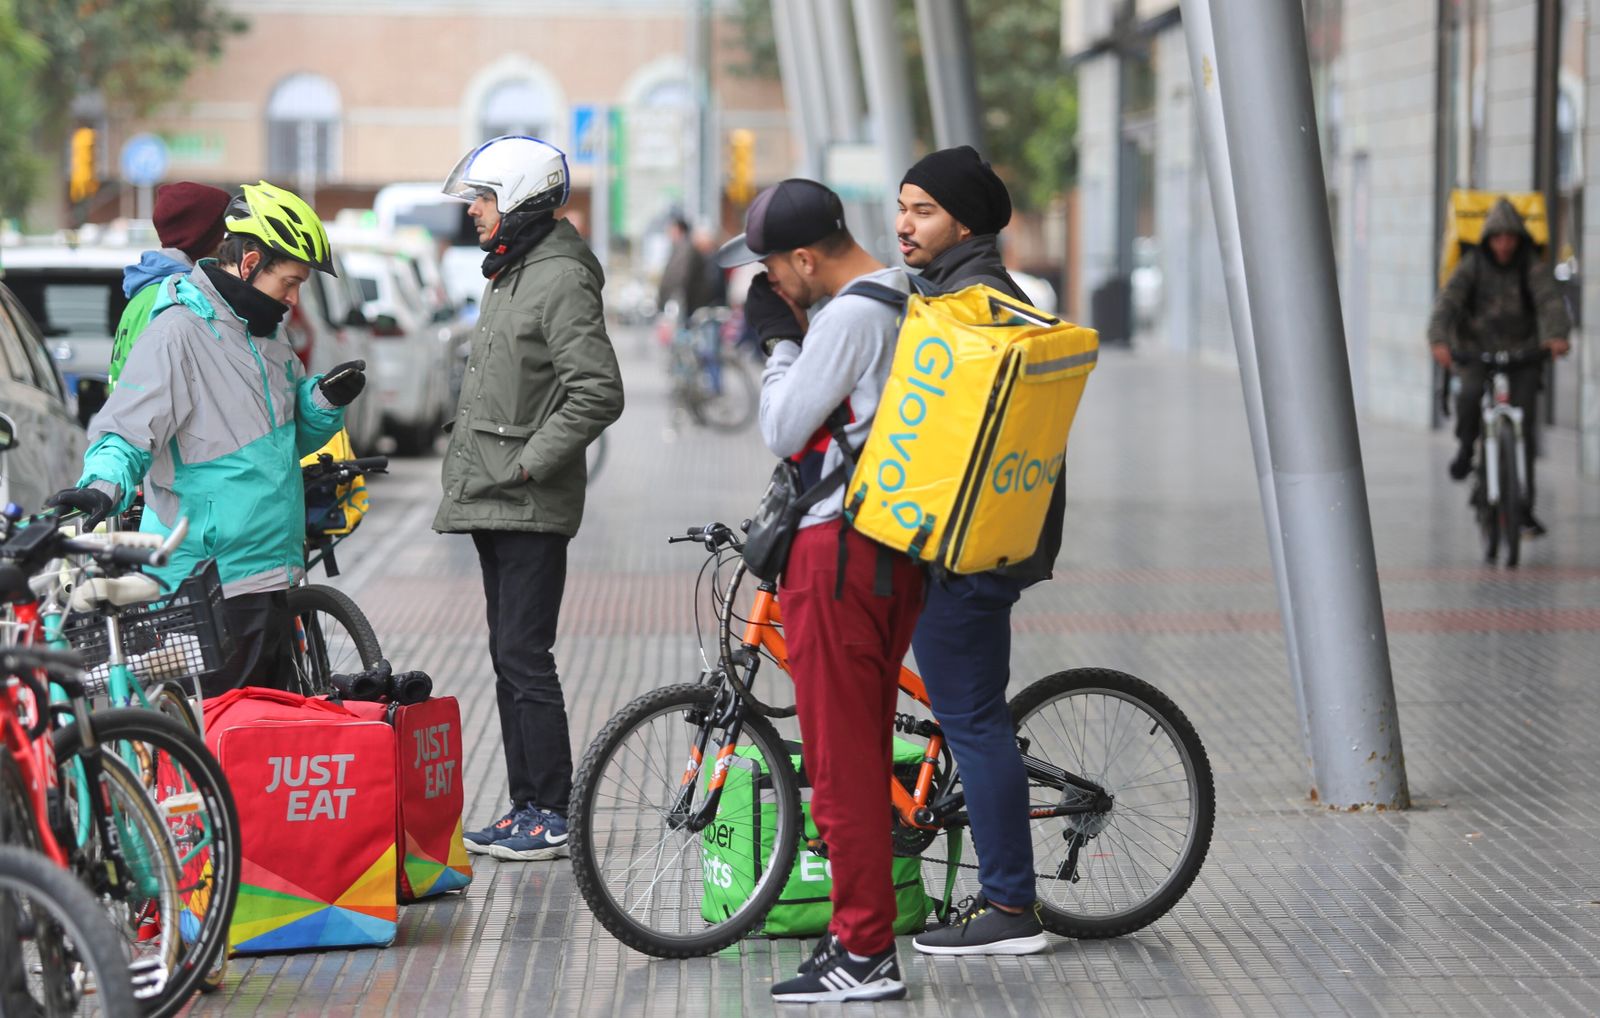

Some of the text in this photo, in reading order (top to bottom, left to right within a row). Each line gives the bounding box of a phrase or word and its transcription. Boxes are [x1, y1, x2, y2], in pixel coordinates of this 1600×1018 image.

[877, 337, 954, 493] Glovo
[413, 722, 450, 769] JUST
[265, 754, 355, 793] JUST
[425, 760, 456, 800] EAT
[287, 788, 357, 822] EAT
[704, 822, 735, 849] ber
